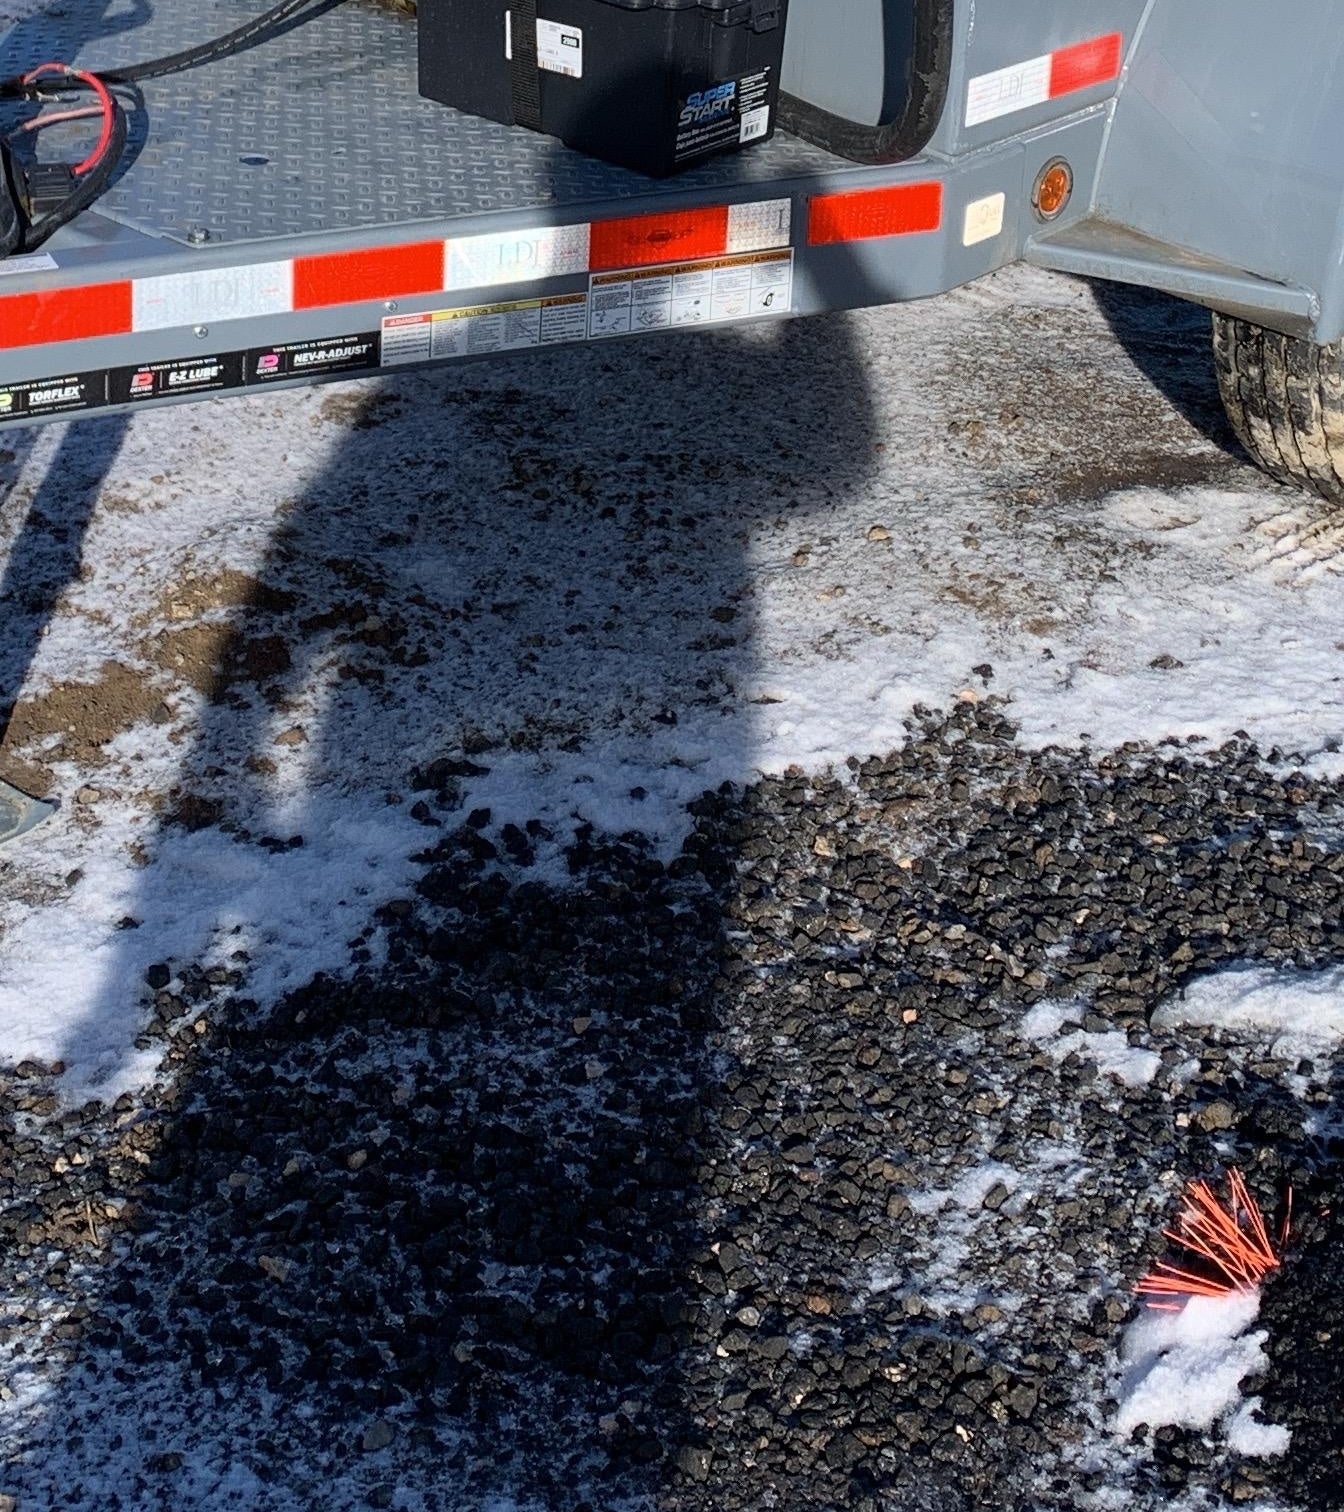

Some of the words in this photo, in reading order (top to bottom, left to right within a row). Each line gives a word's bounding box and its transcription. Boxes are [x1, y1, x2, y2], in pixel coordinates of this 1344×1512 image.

[686, 80, 736, 107] SUPER
[678, 94, 736, 127] START
[293, 343, 368, 365] NEV-R-ADJUST
[169, 369, 188, 383] E-Z
[189, 364, 219, 379] LUBE
[28, 385, 80, 402] TORFLEX
